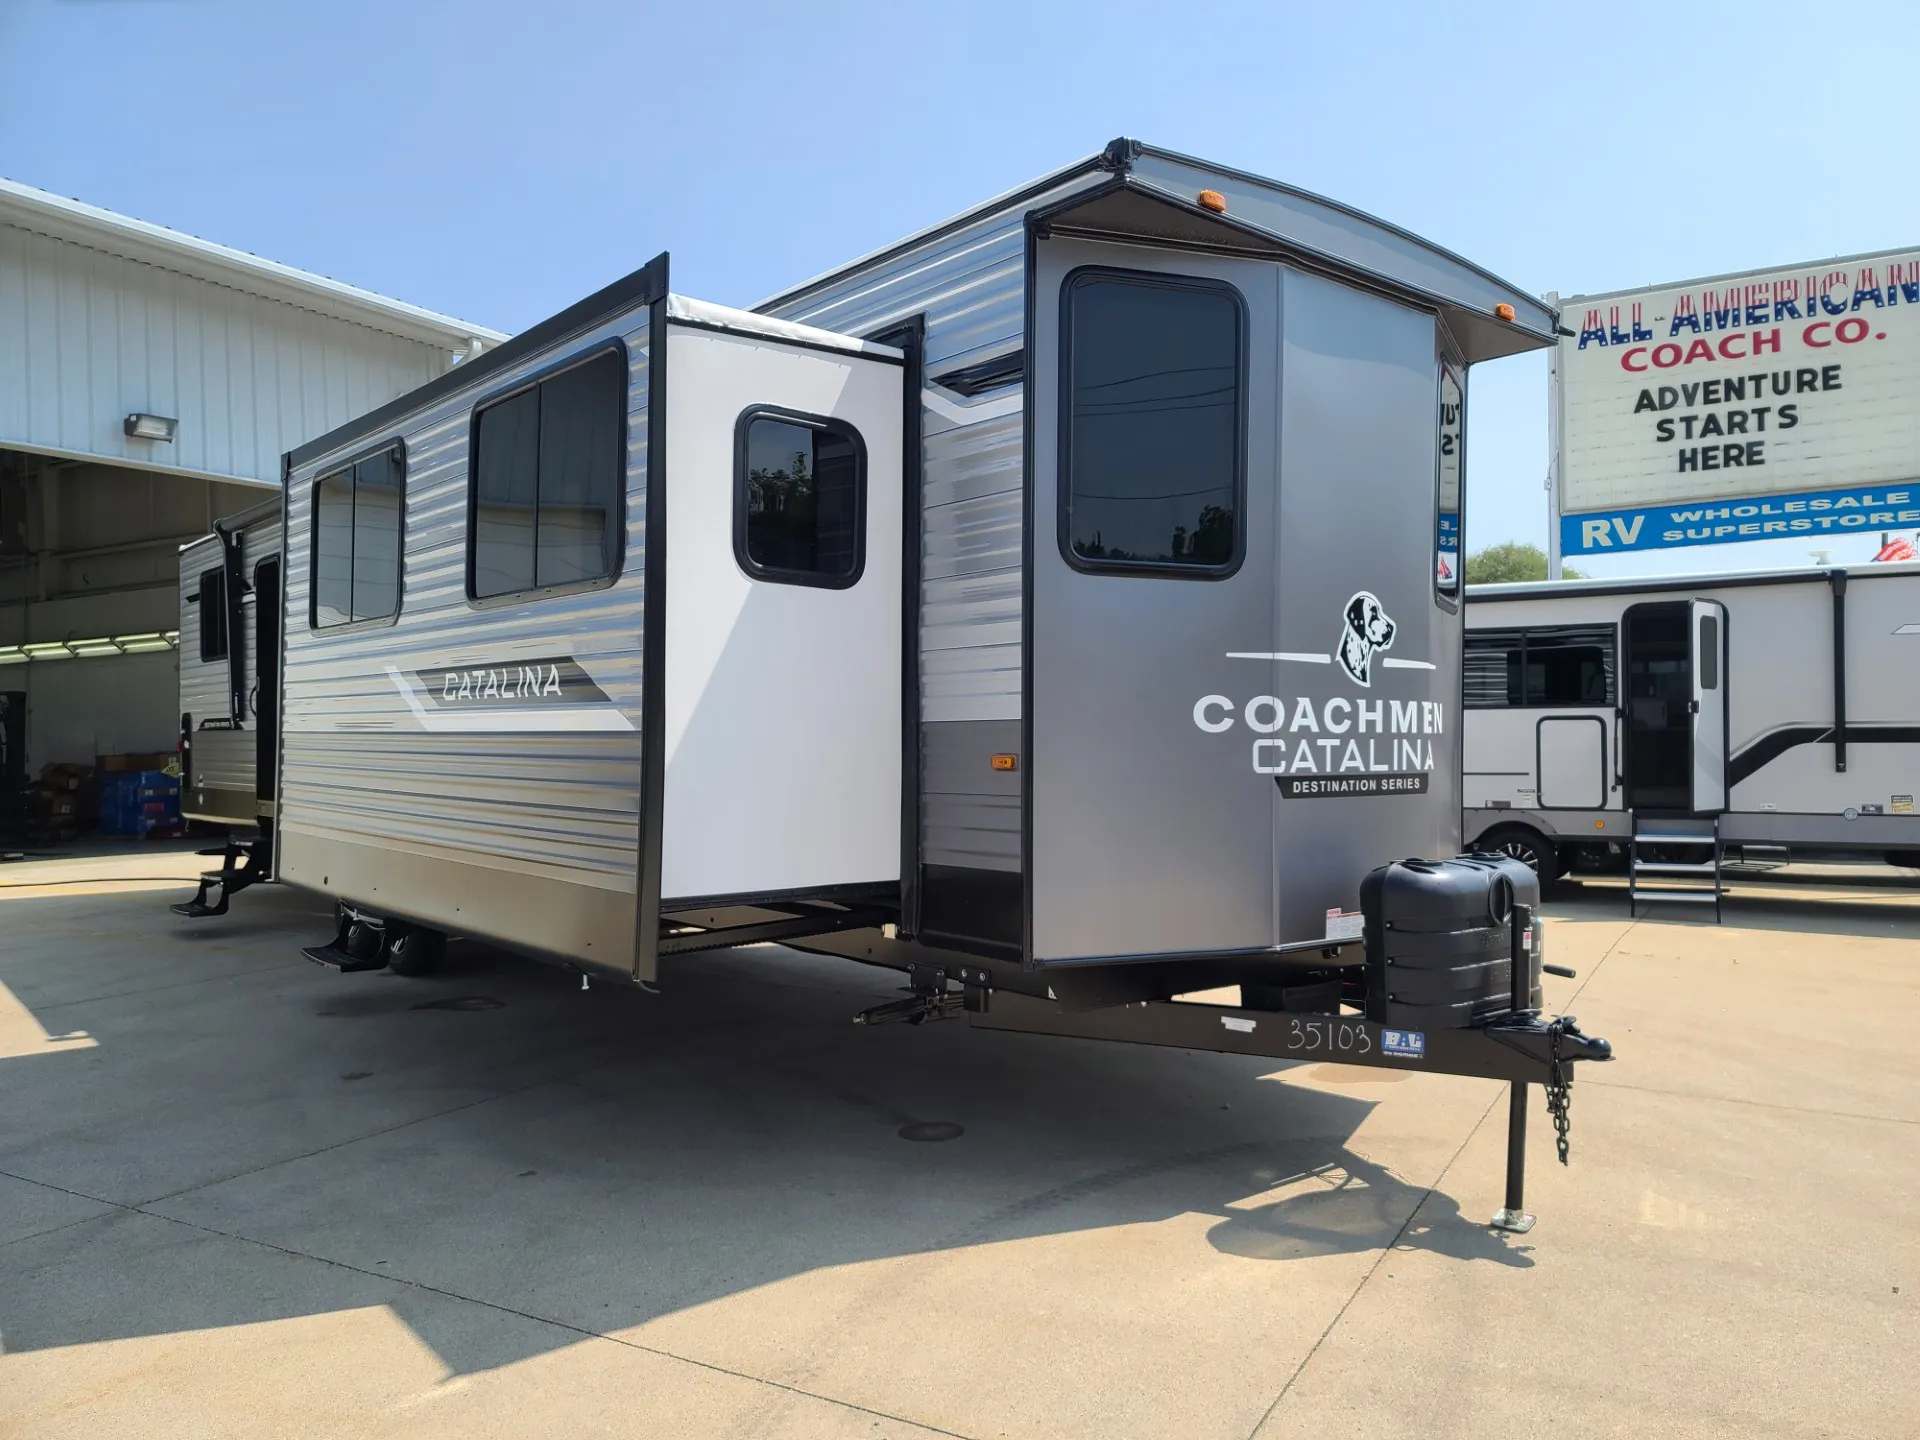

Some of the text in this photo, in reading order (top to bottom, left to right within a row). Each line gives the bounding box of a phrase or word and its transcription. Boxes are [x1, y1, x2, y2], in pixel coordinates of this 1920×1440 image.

[1620, 317, 1887, 373] COACH CO.
[1634, 364, 1843, 414] ADVENTURE
[1656, 404, 1799, 442] STARTS
[1678, 440, 1765, 473] HERE
[1670, 491, 1911, 523] WHOLESALE
[1581, 515, 1645, 549] RV
[1662, 510, 1920, 542] SUPERSTORE
[442, 664, 563, 701] CATALINA
[1192, 694, 1443, 734] COACHMEN
[1252, 738, 1435, 774] CATALINA
[1292, 777, 1421, 794] DESTINATION SERIES
[1287, 1018, 1372, 1054] 35103
